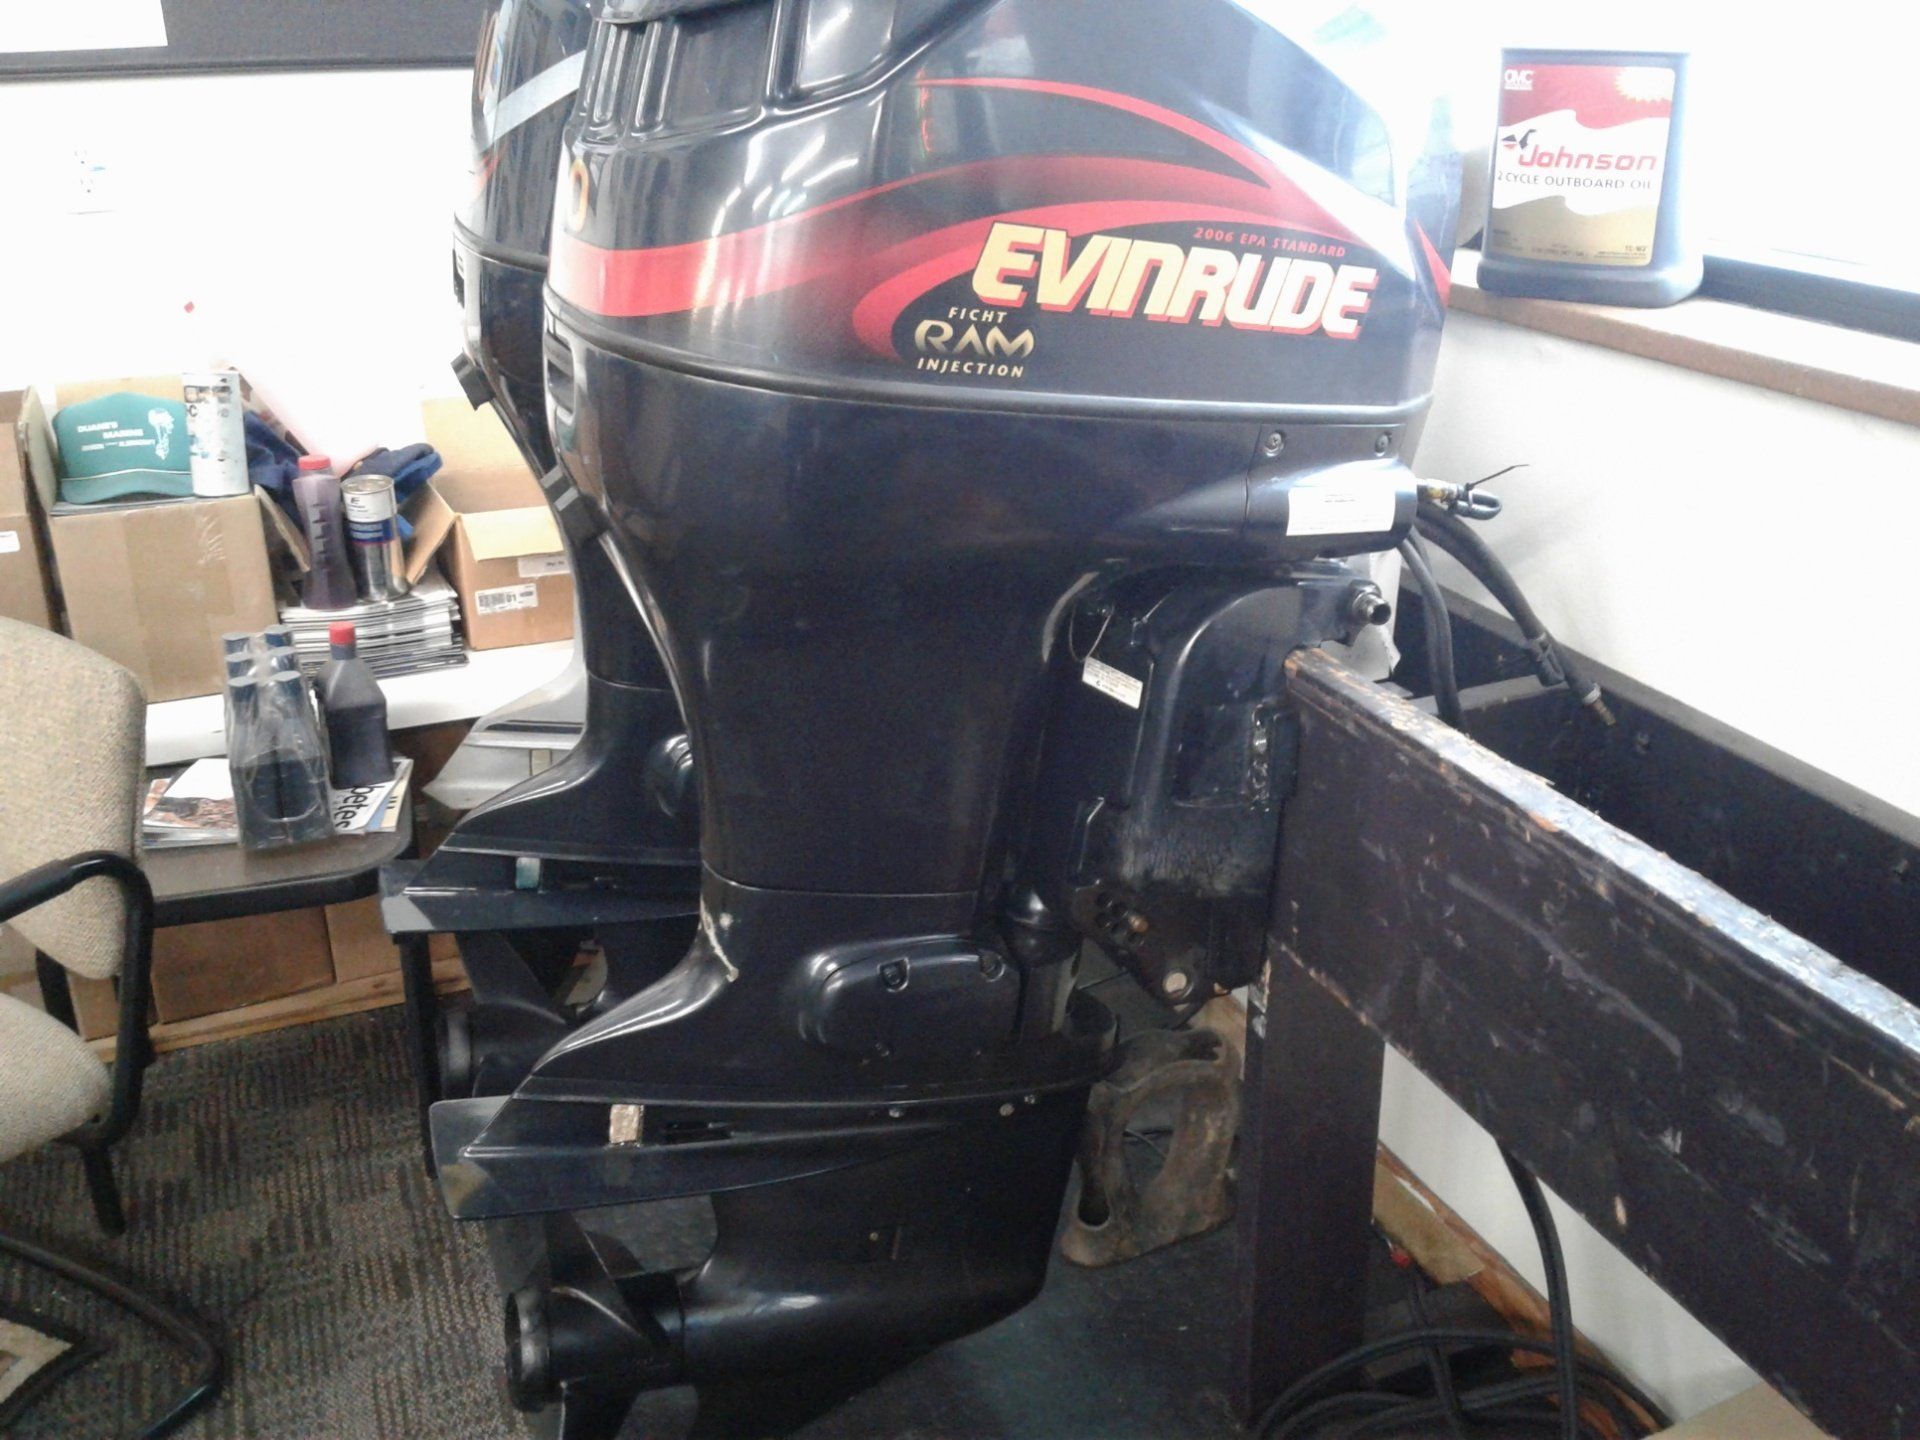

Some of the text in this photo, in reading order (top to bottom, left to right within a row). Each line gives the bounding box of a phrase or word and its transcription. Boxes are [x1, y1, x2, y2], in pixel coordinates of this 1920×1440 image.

[1504, 69, 1534, 84] OMC
[1517, 144, 1657, 171] Johnson
[1505, 172, 1539, 185] CYCLE
[1544, 175, 1625, 189] OUTBOARD
[1193, 227, 1346, 257] 2006 EPA STANDARD
[971, 221, 1377, 339] EVINRUDE
[948, 306, 1008, 323] FICHT
[914, 319, 1035, 359] RAM
[917, 357, 1024, 378] INJECTION
